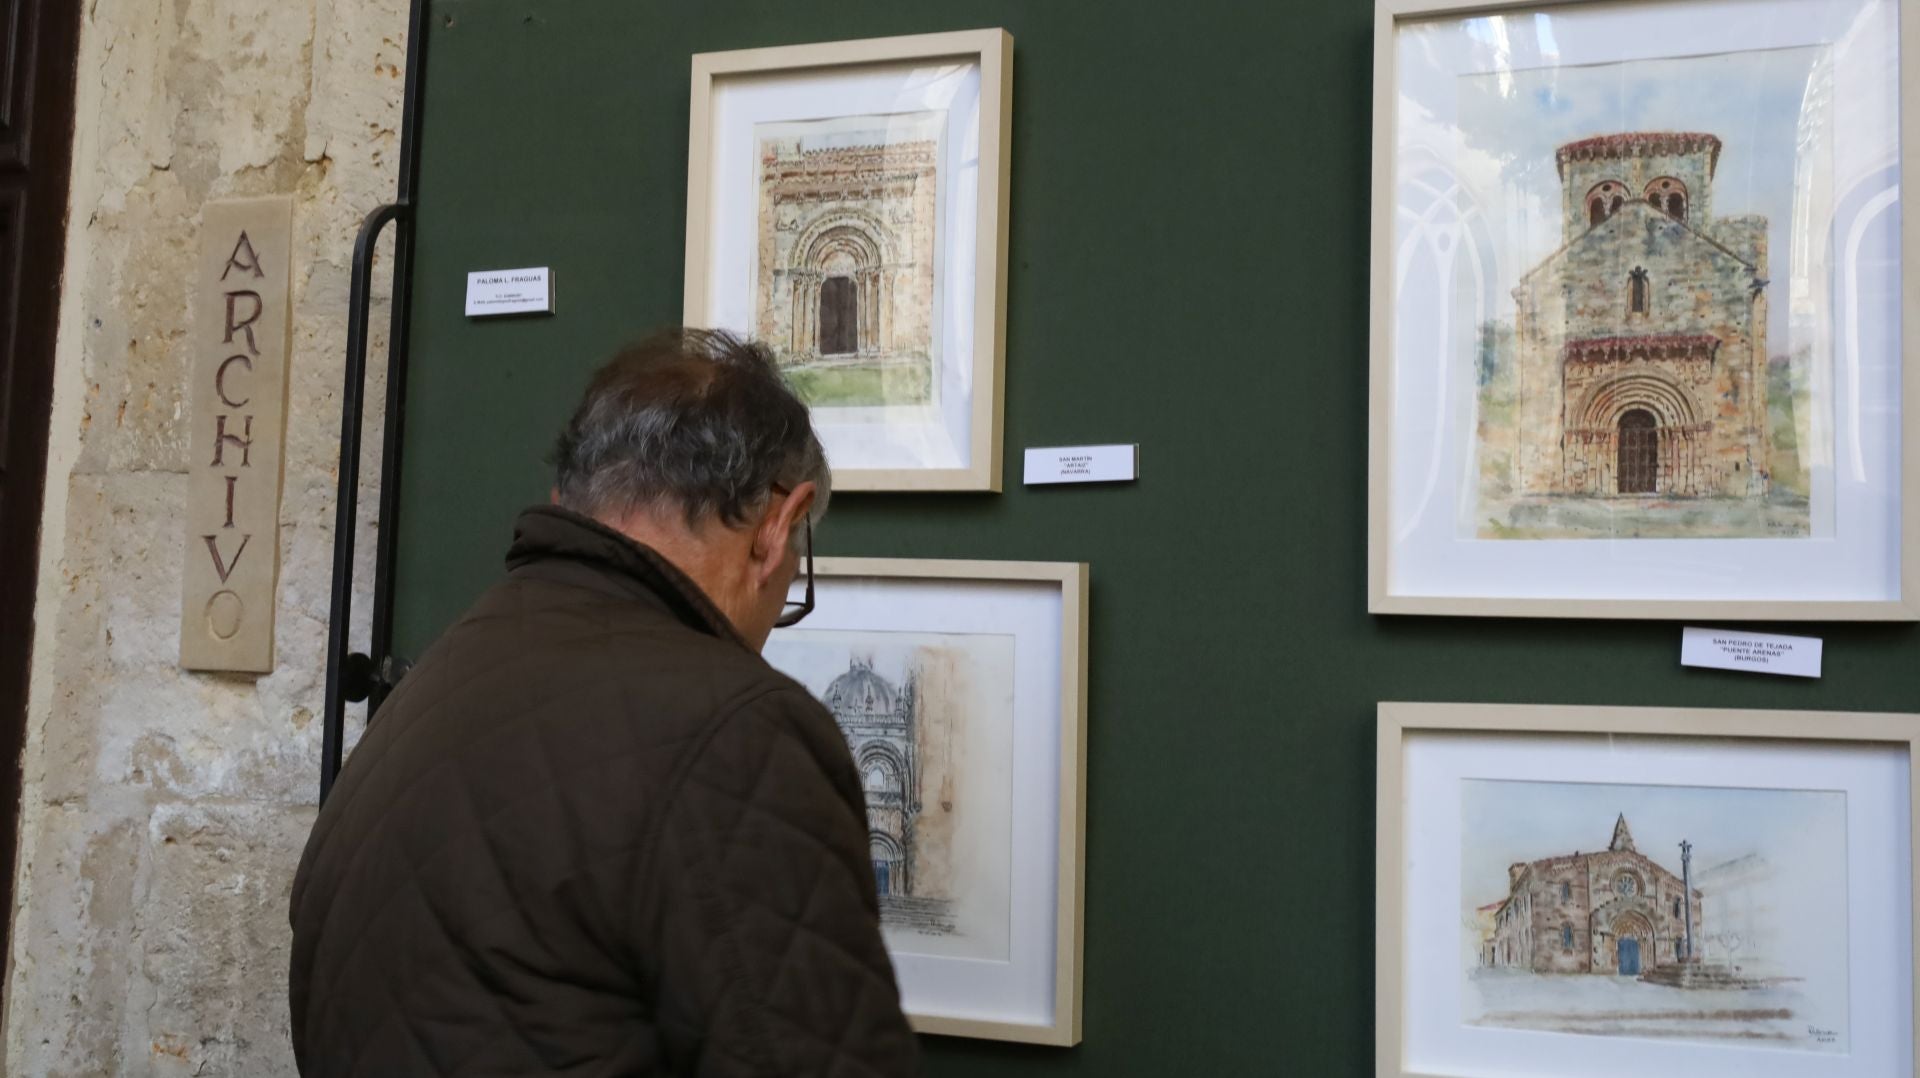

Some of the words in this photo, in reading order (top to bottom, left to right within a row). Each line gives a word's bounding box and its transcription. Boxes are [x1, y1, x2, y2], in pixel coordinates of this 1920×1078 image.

[201, 229, 265, 640] ARCHIVO
[1728, 639, 1752, 647] PEDRO
[1734, 655, 1769, 663] (BURGOS)
